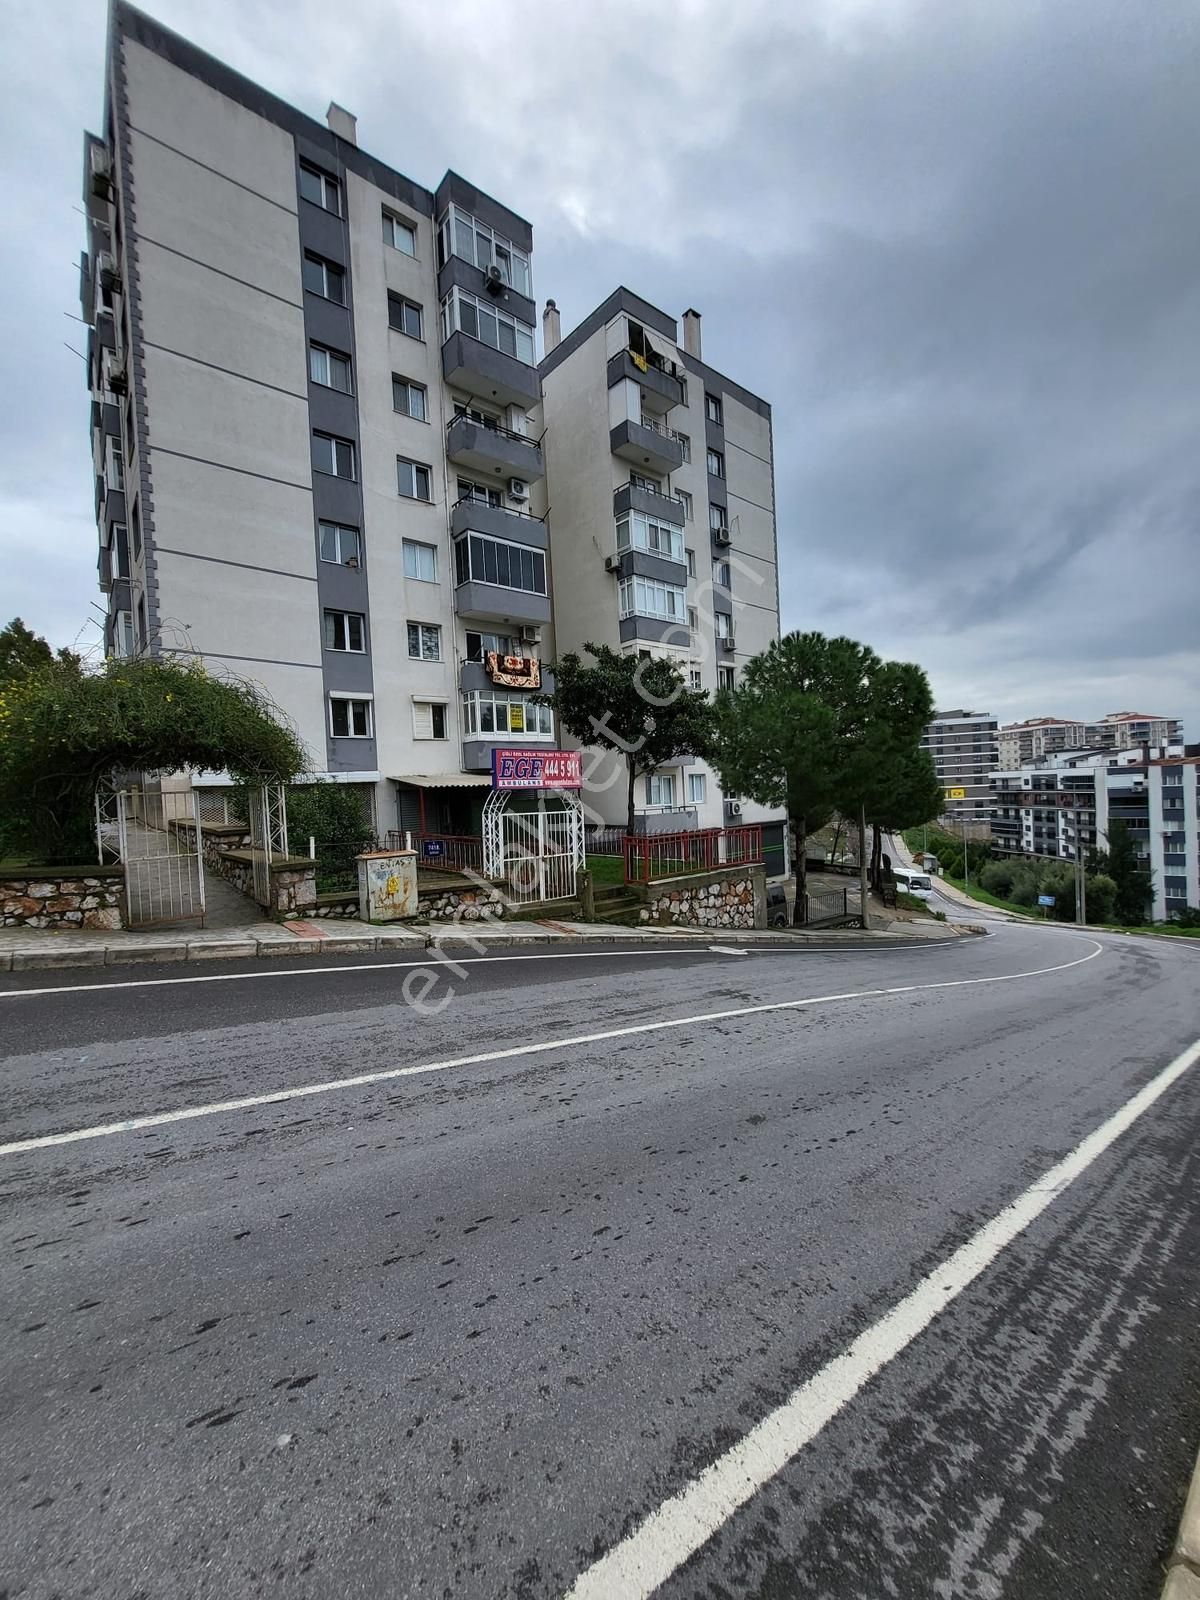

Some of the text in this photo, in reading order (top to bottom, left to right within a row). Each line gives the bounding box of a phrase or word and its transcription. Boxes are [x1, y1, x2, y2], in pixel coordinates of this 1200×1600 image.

[498, 757, 544, 779] EGE
[545, 760, 580, 777] 444 5 911
